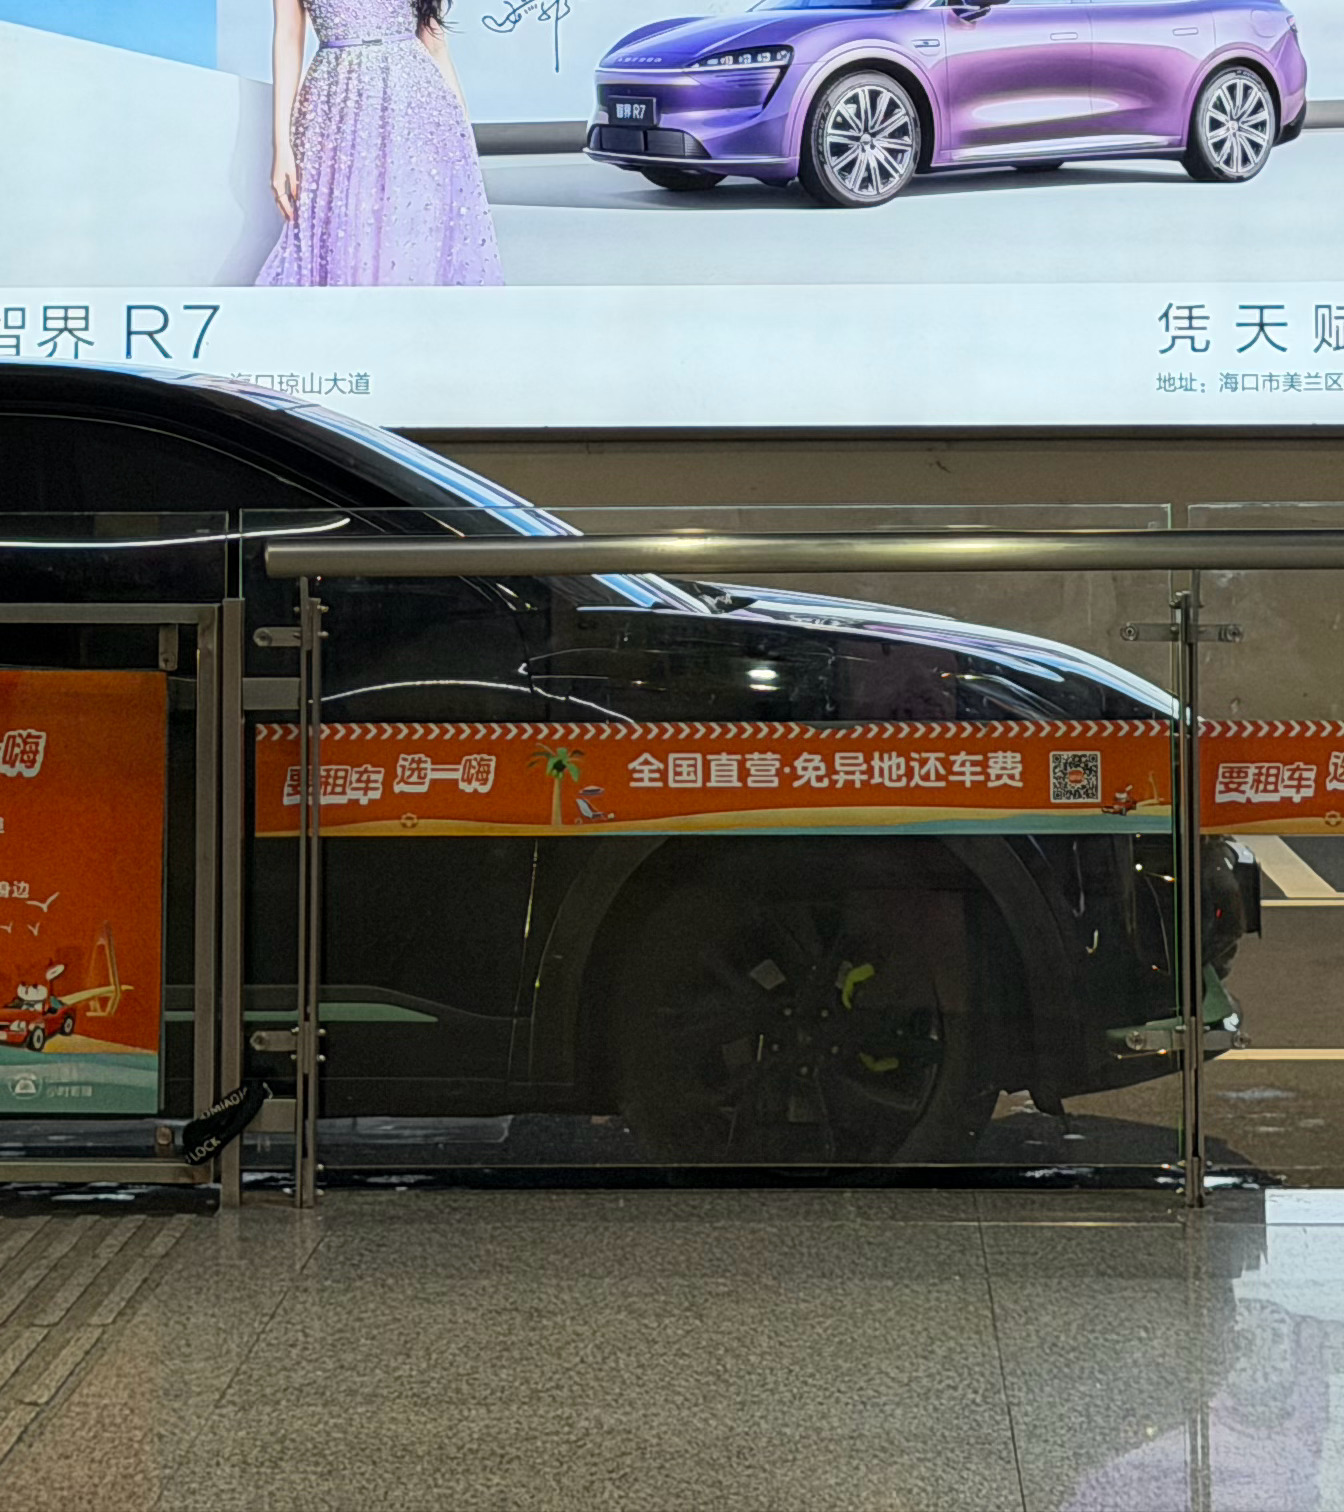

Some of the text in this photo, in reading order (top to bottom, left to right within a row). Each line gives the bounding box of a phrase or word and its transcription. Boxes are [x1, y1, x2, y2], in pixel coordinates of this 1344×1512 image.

[126, 304, 221, 360] R7
[283, 751, 1024, 805] 要租车 选一嗨 全国直营·免异地还车费
[1215, 762, 1317, 803] 要租车
